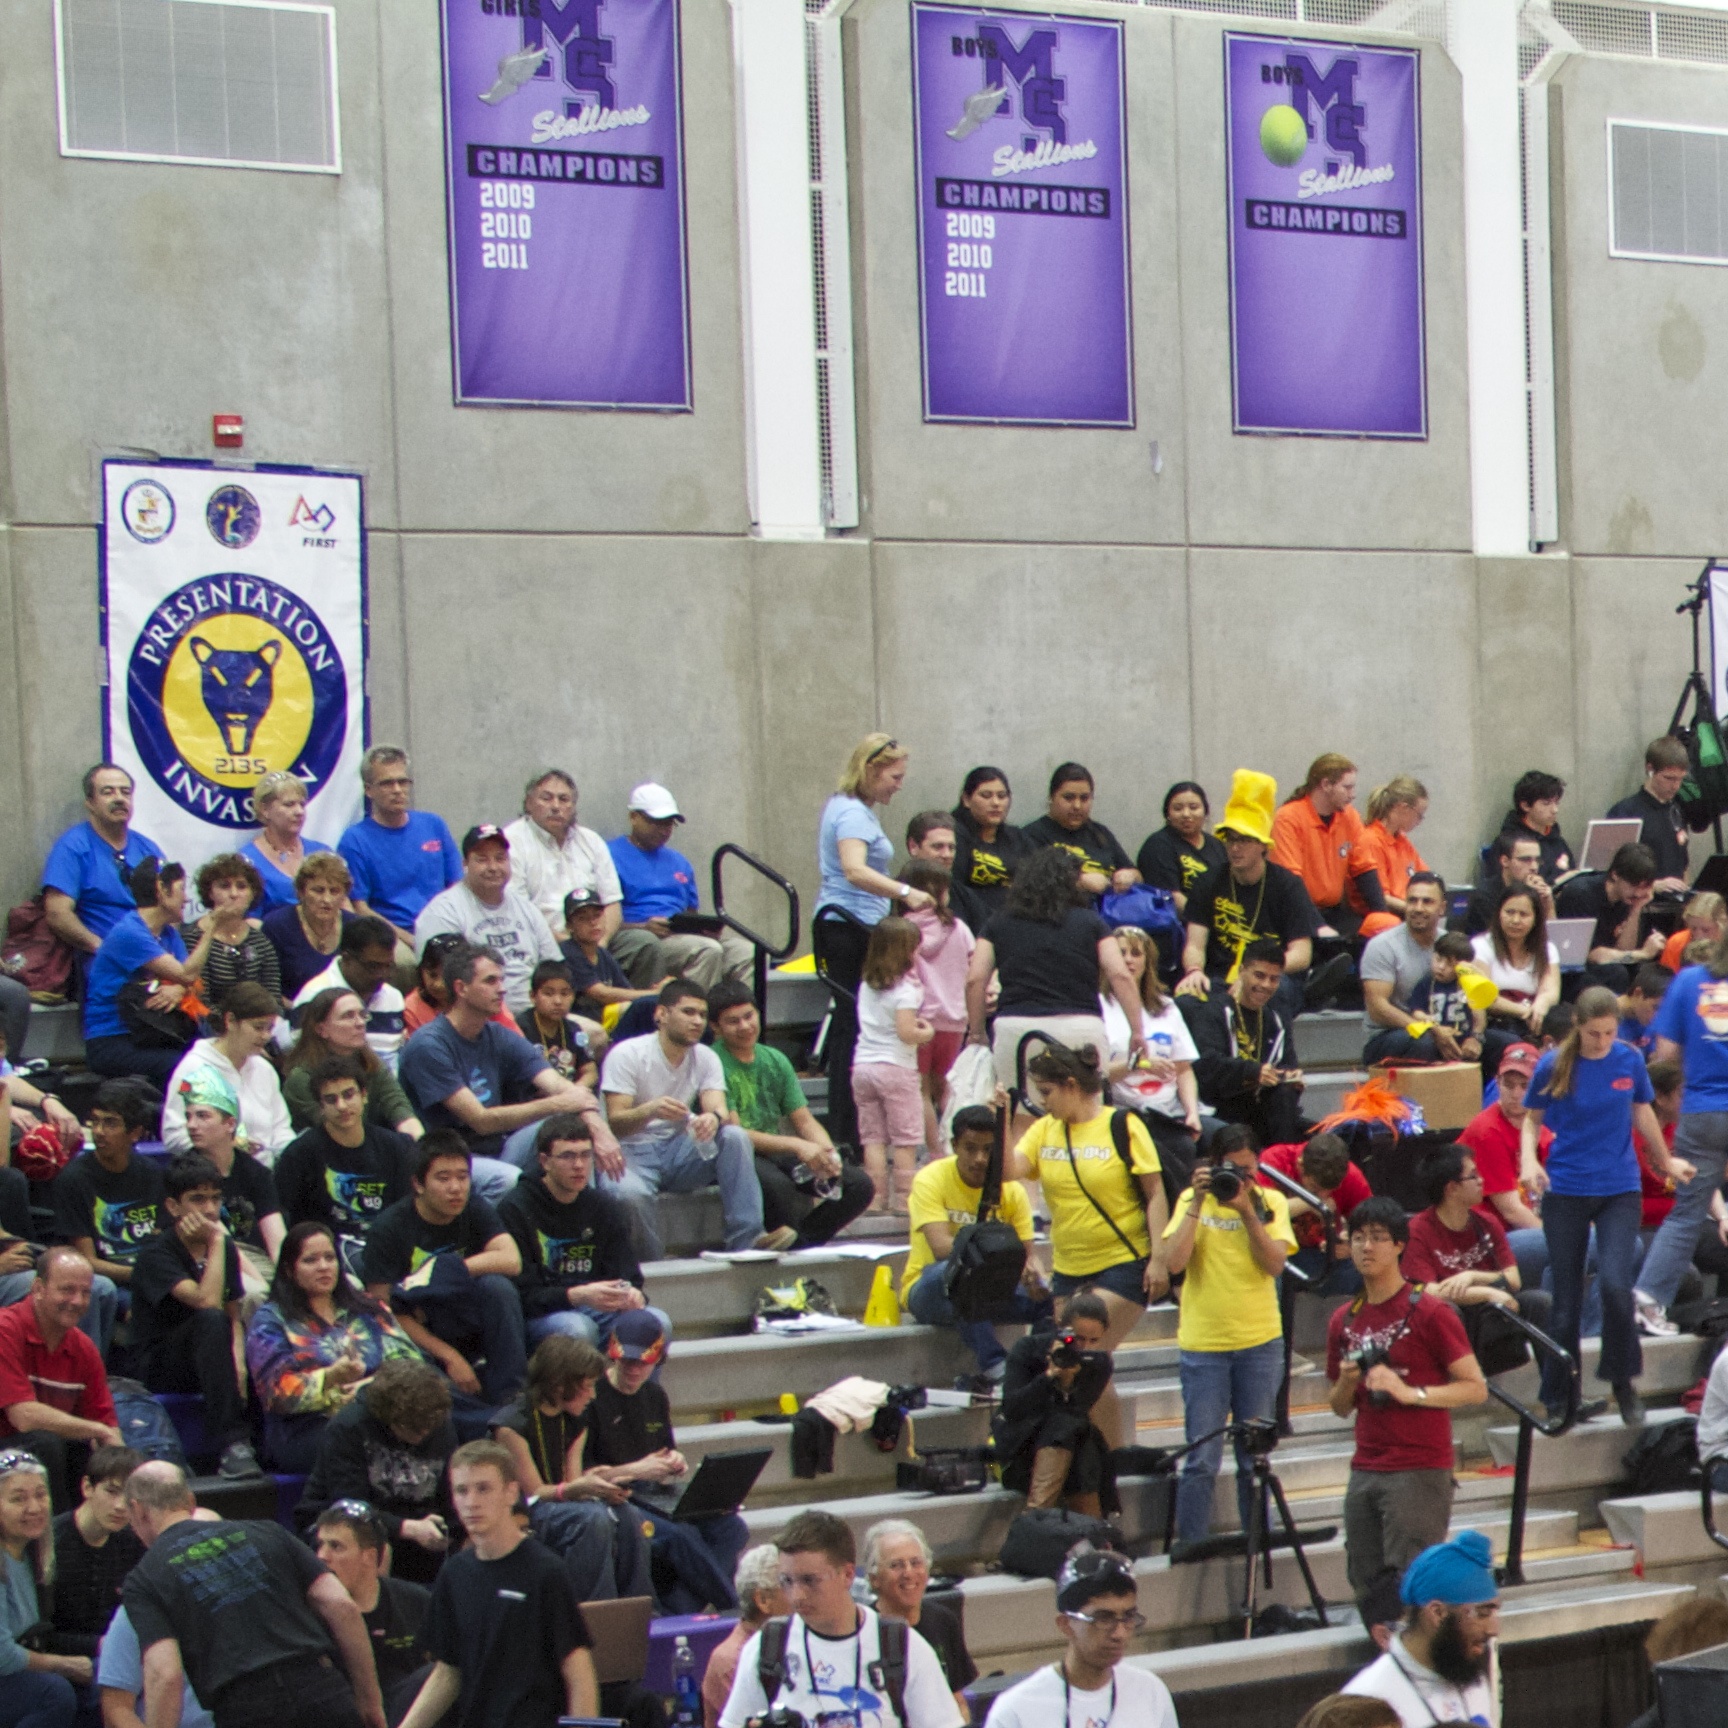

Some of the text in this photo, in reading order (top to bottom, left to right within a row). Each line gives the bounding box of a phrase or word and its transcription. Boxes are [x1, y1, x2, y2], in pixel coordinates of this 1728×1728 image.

[531, 104, 651, 143] Stallions
[477, 151, 658, 183] CHAMPIONS
[991, 140, 1097, 177] Stallions
[1297, 164, 1395, 199] Stallions
[480, 182, 535, 209] 2009
[944, 184, 1105, 213] CHAMPIONS
[481, 212, 531, 239] 2010
[946, 213, 995, 239] 2009
[1253, 205, 1400, 235] CHAMPIONS
[482, 242, 529, 269] 2011
[947, 244, 992, 268] 2010
[945, 273, 986, 297] 2011
[302, 537, 337, 548] FIRST
[139, 580, 336, 672] PRESENTATION
[215, 757, 268, 775] 2135
